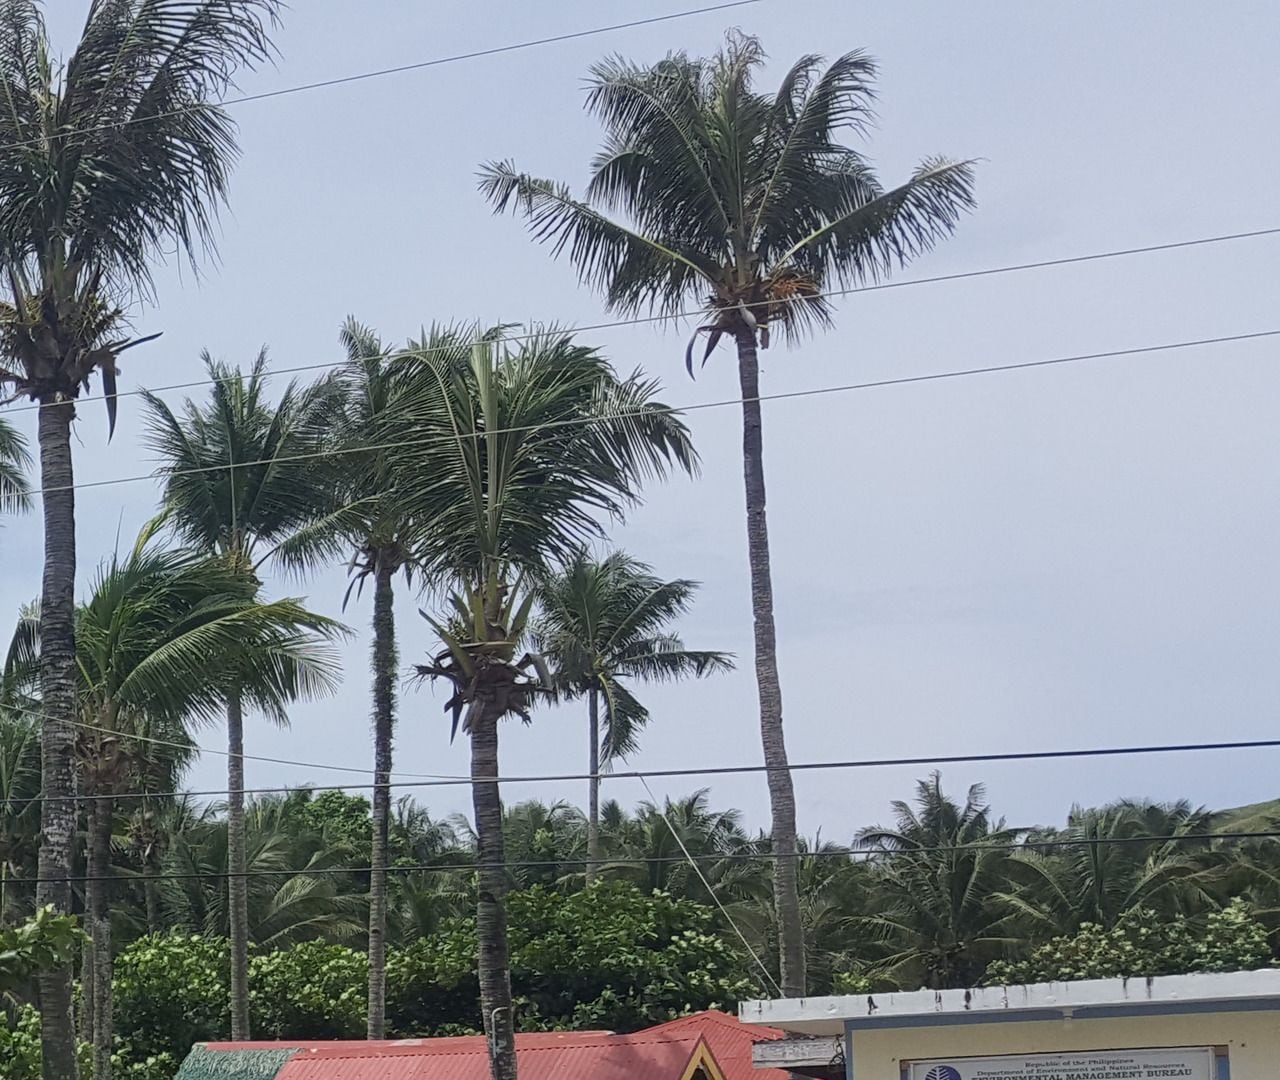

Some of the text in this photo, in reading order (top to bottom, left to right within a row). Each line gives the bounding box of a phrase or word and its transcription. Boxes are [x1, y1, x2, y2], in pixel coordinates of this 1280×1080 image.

[977, 1069, 1023, 1077] Department
[1066, 1071, 1144, 1080] MANAGEMENT
[1147, 1069, 1192, 1077] BUREAU
